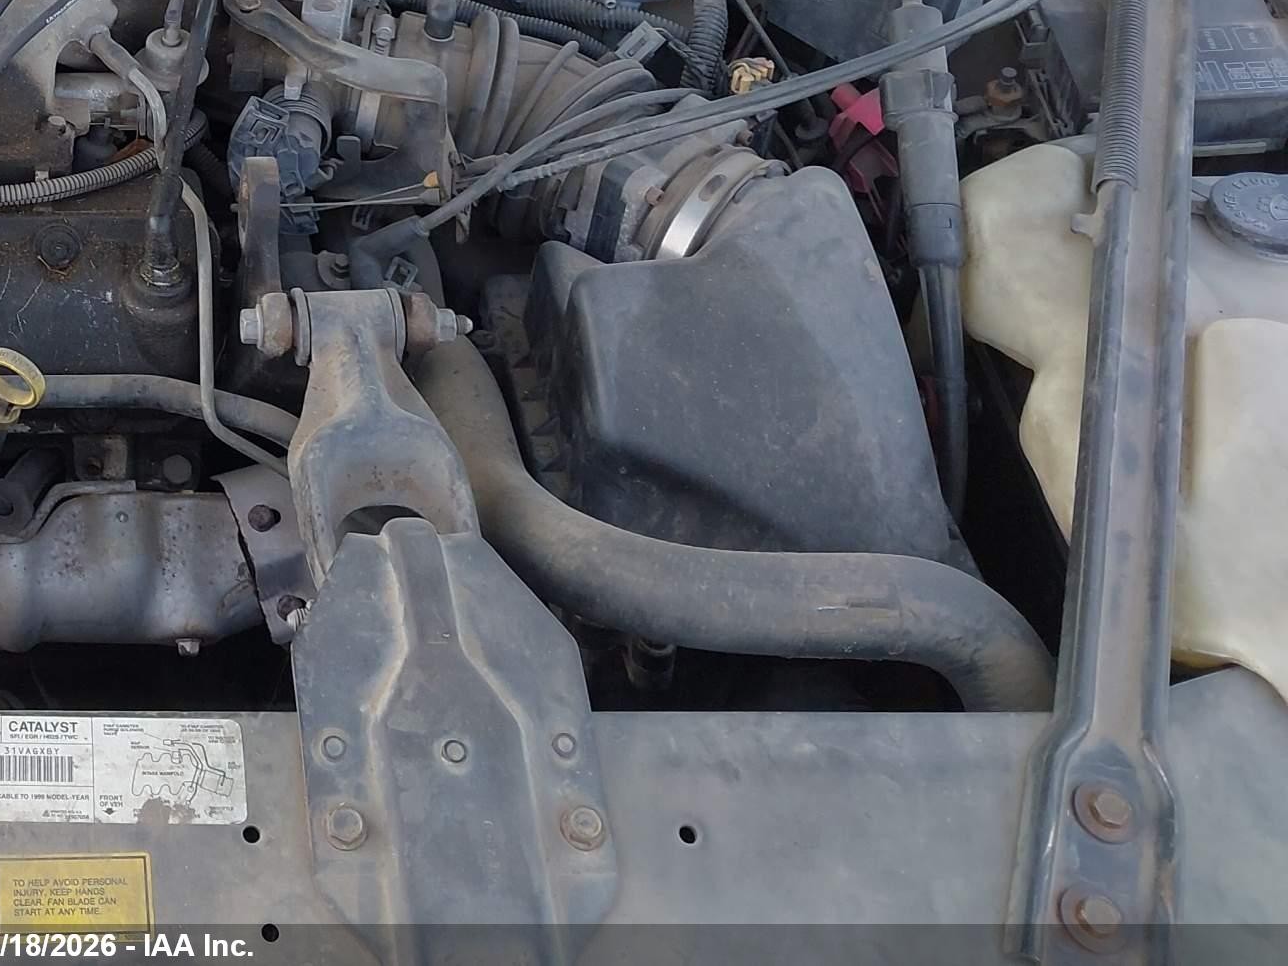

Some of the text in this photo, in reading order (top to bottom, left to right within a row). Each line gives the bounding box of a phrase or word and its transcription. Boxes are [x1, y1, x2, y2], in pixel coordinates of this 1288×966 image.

[9, 721, 78, 732] CATALYST
[13, 879, 25, 887] TO
[53, 878, 78, 886] AVOID
[82, 878, 127, 886] PERSONAL
[75, 888, 105, 896] HANDS
[47, 898, 64, 906] FAN
